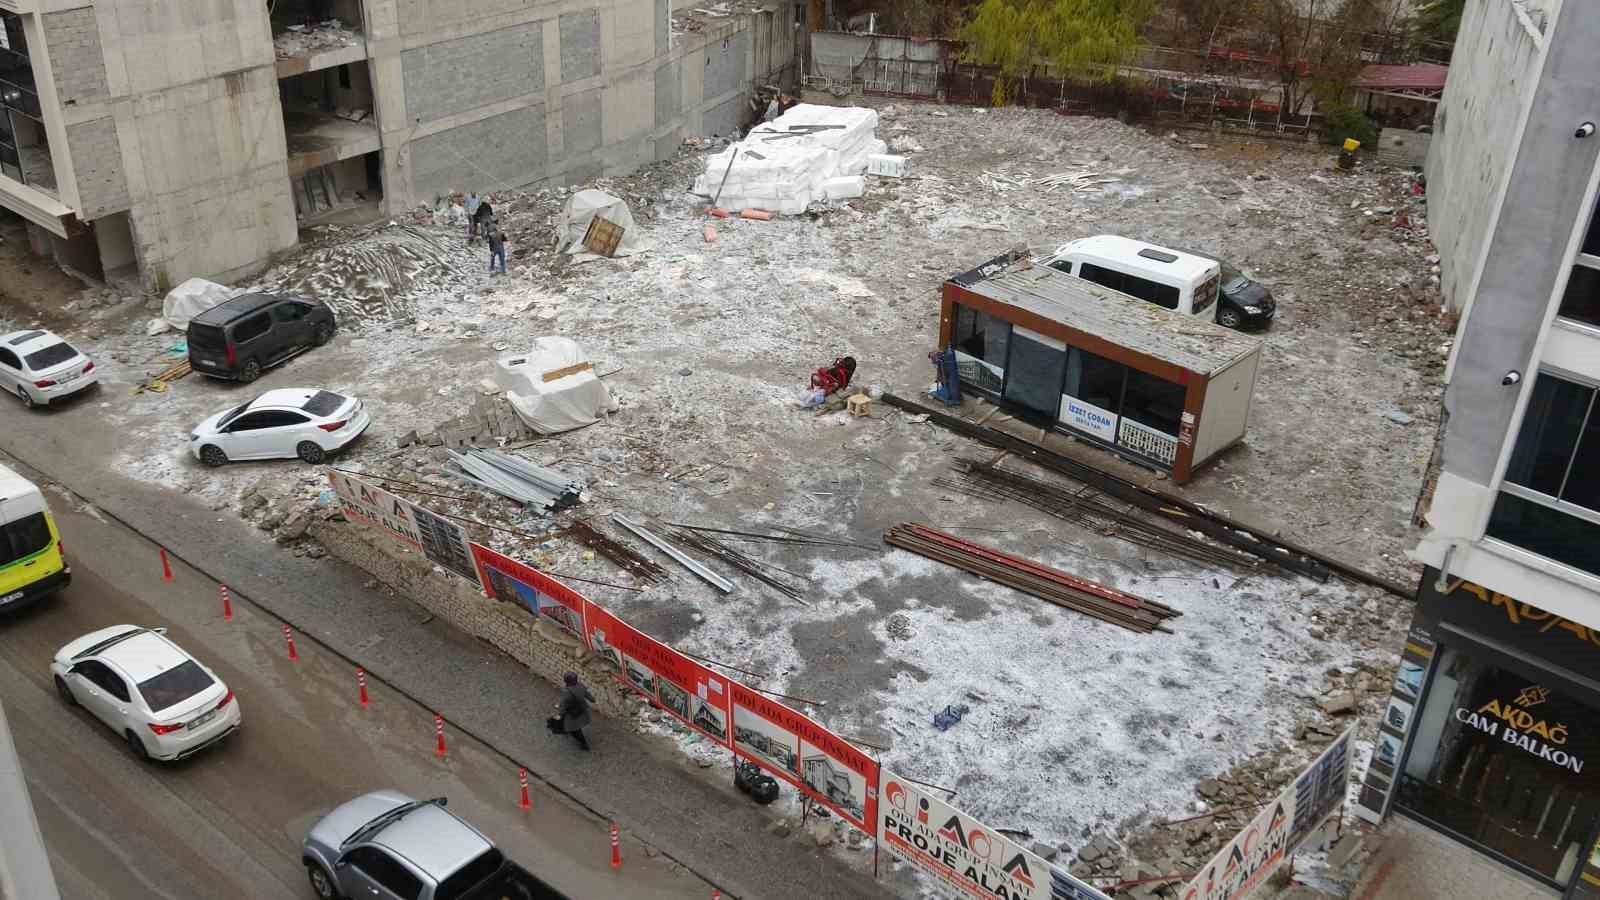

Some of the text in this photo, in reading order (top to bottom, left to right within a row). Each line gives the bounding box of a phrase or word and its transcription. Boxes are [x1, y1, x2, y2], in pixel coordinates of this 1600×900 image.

[1455, 707, 1584, 774] CAM BALKON
[1478, 699, 1569, 745] AKDAĞ
[885, 815, 957, 870] PROJE
